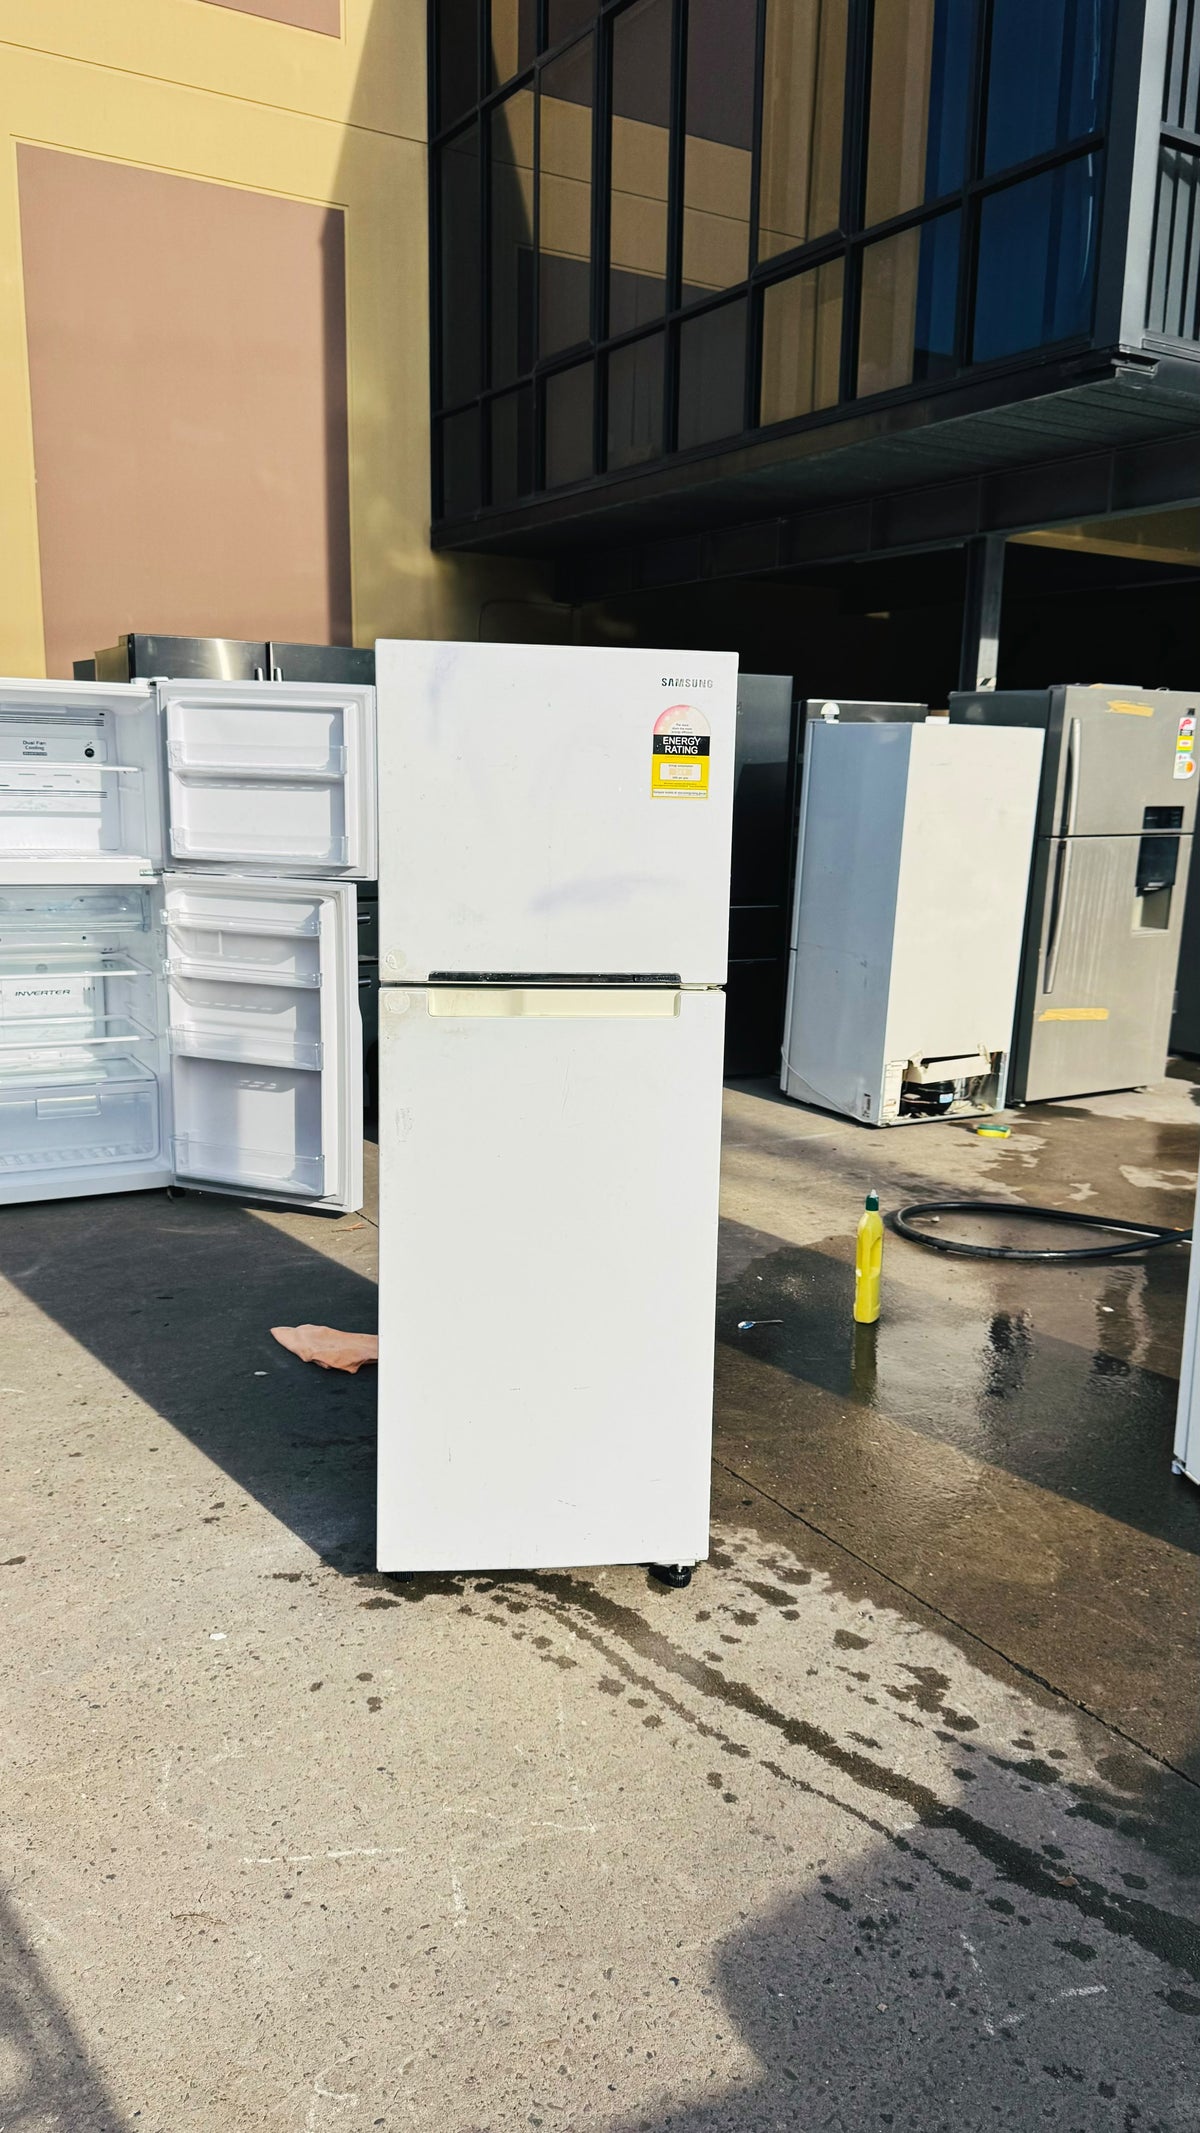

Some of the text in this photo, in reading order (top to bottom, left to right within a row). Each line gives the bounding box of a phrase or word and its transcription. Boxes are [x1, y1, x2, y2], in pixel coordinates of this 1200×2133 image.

[661, 677, 713, 689] SAMSUNG
[662, 736, 701, 746] ENERGY
[664, 745, 699, 755] RATING
[15, 989, 71, 997] INVERTER
